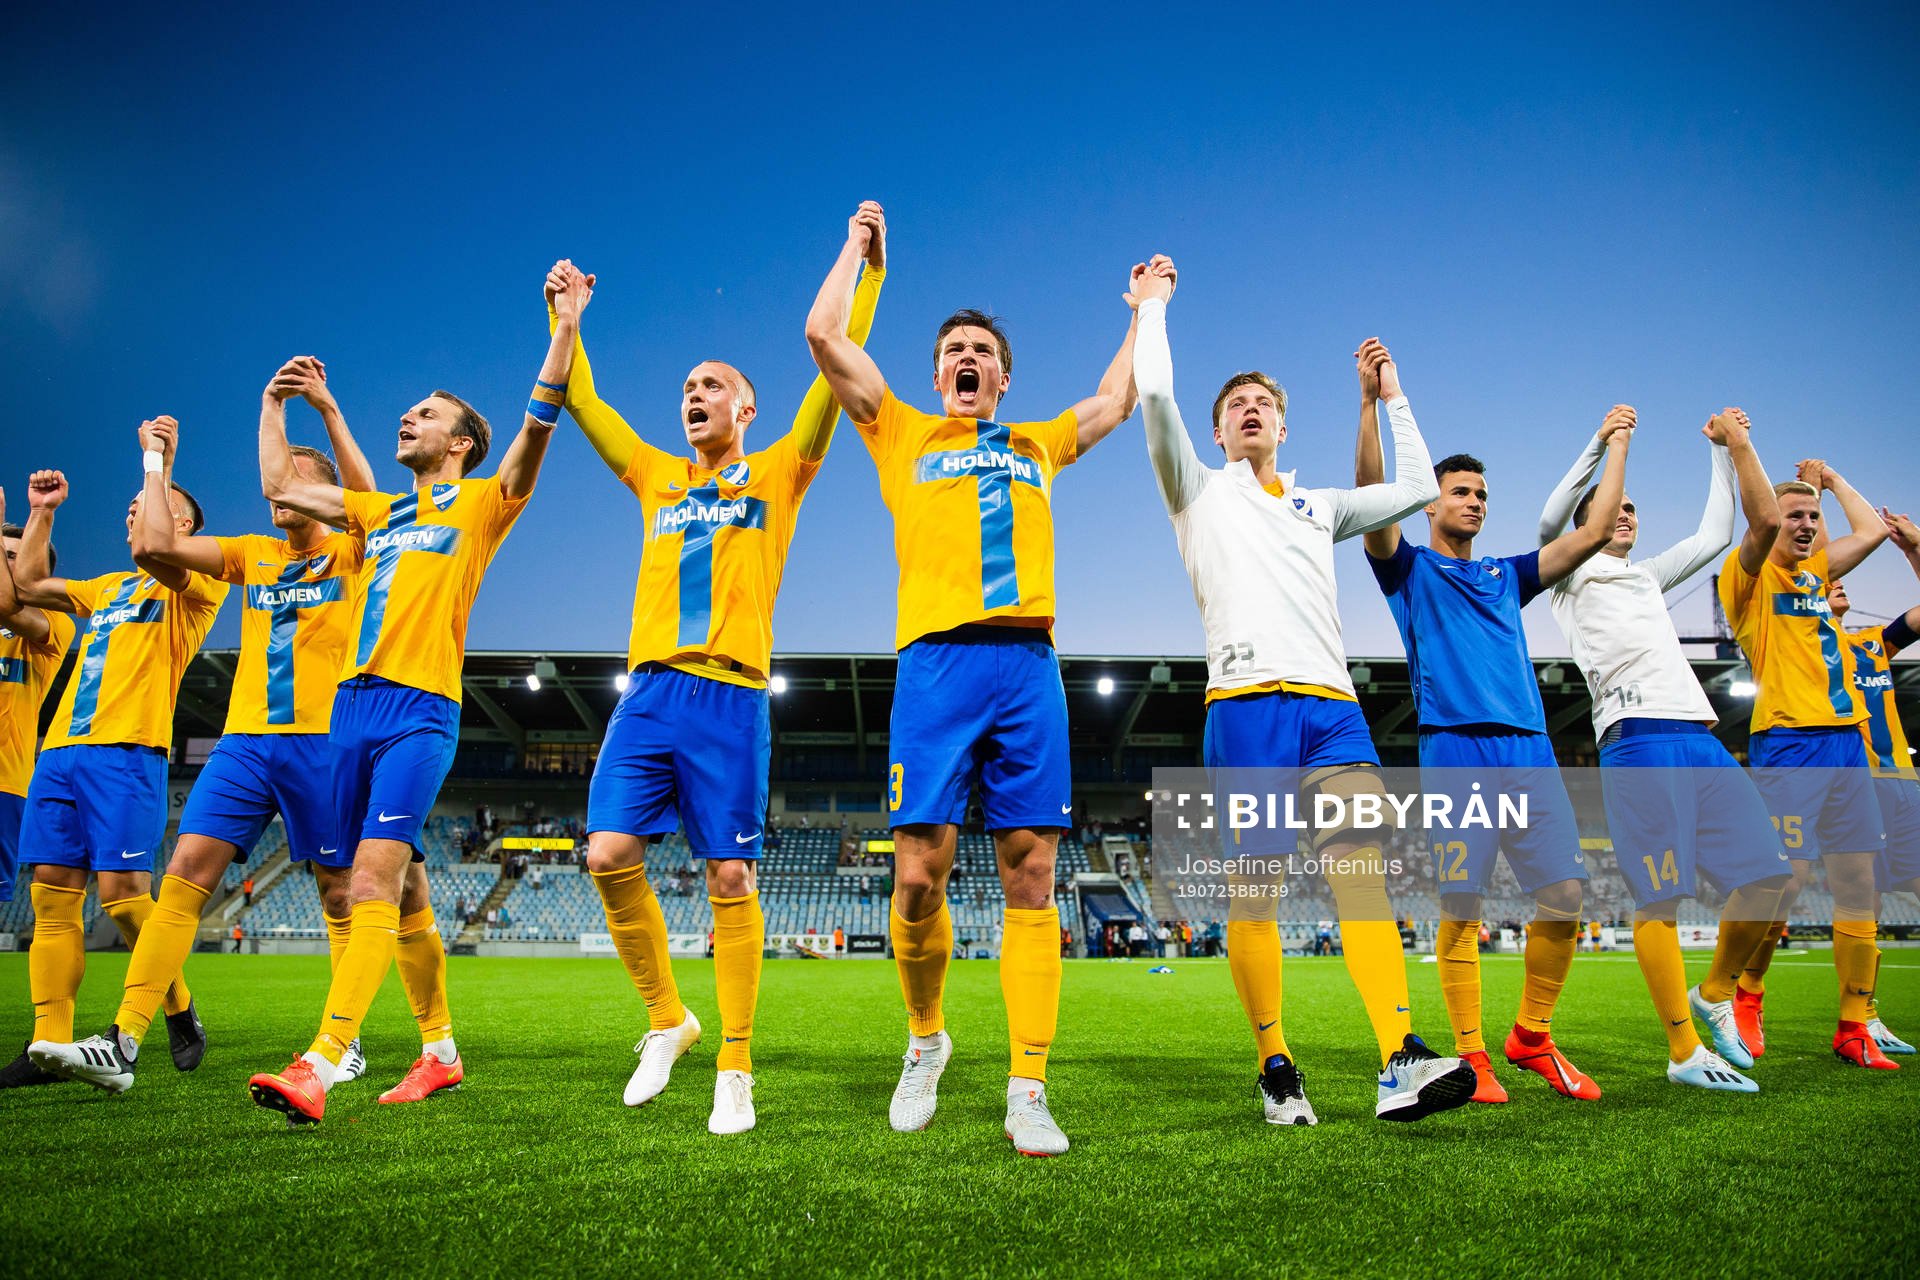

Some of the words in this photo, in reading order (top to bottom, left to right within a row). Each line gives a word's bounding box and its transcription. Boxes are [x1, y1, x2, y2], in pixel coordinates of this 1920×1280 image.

[942, 451, 1032, 479] HOLMN
[662, 502, 747, 527] HOLMEN
[1221, 641, 1255, 676] 23
[1642, 849, 1679, 891] 14
